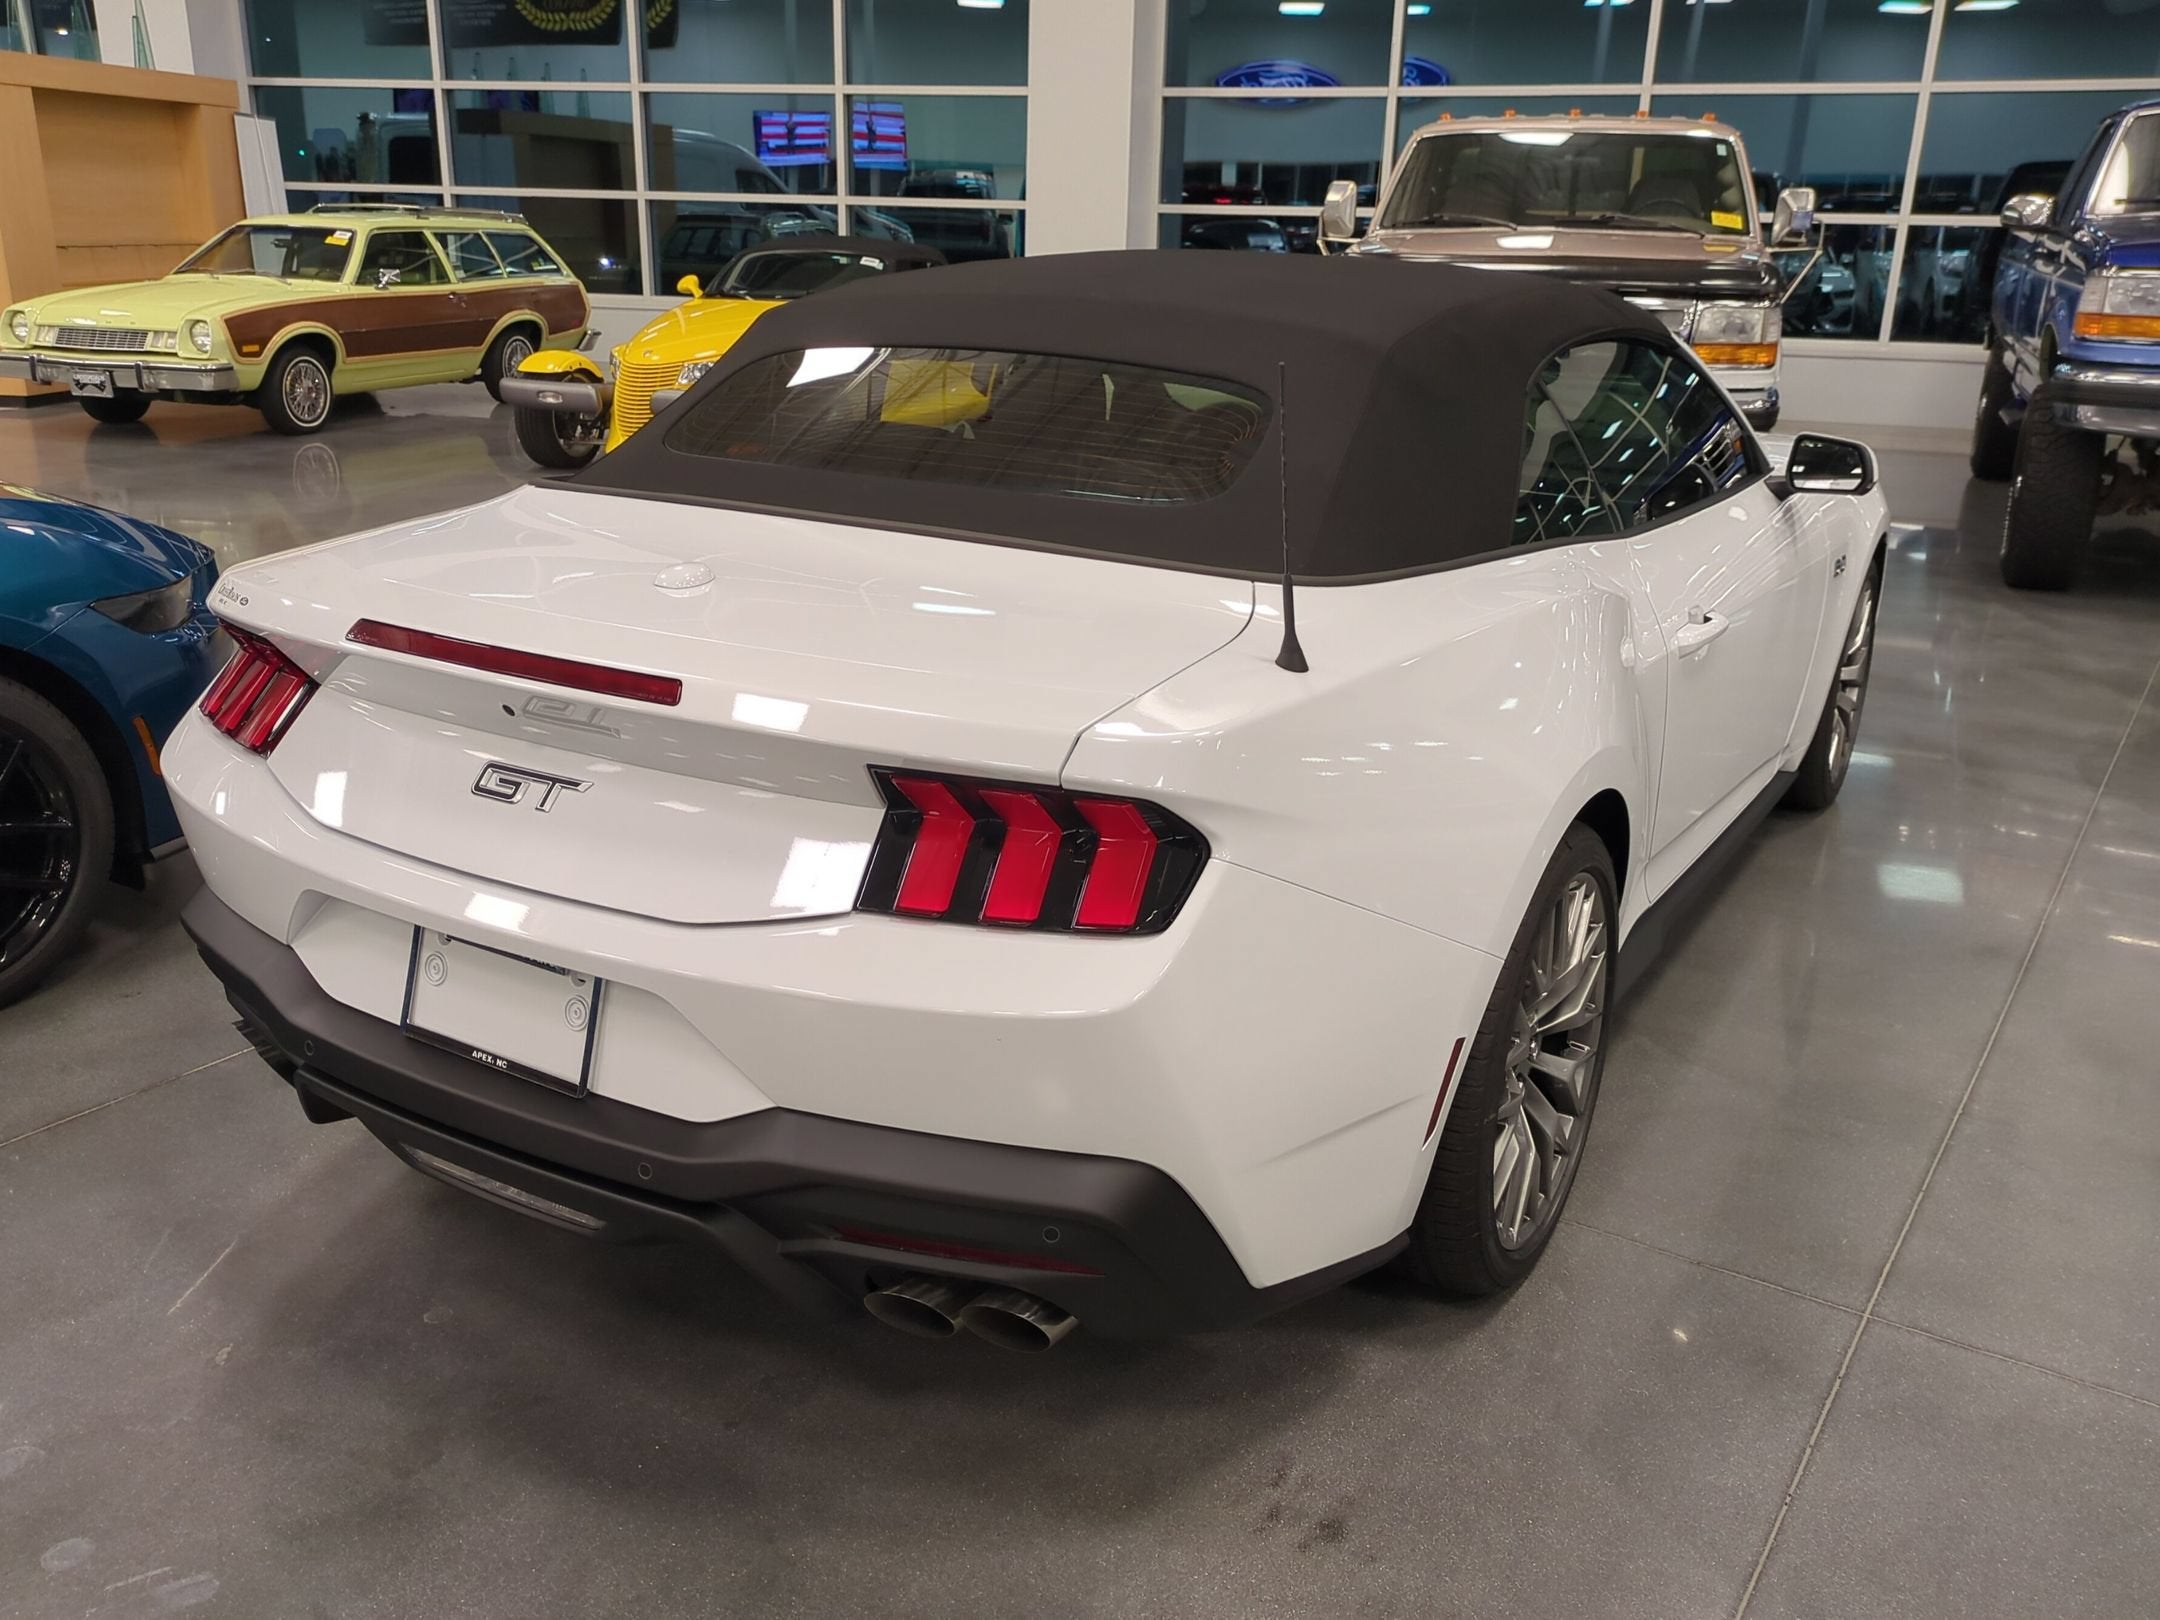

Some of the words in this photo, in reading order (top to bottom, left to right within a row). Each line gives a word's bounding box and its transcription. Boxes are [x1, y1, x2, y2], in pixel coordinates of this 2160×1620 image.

[471, 760, 594, 813] GT
[472, 1050, 494, 1065] APEX,
[496, 1058, 508, 1069] NC
